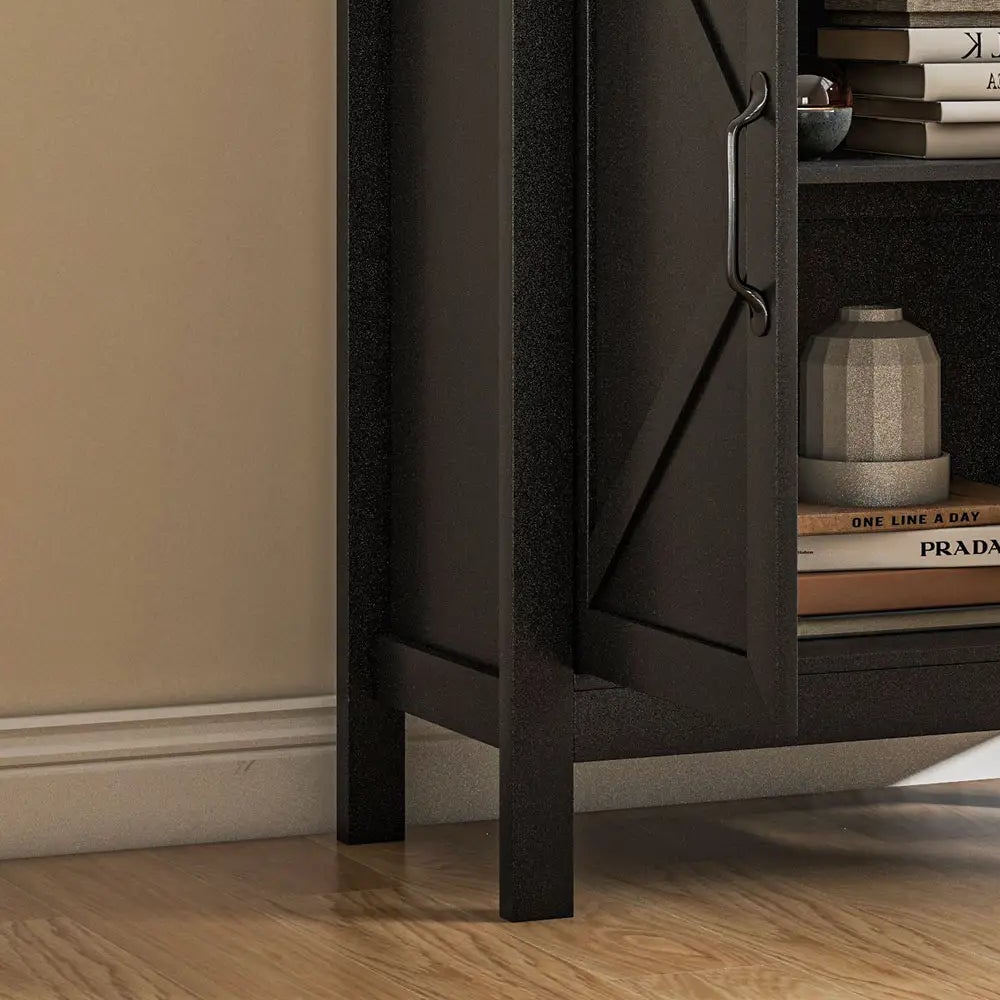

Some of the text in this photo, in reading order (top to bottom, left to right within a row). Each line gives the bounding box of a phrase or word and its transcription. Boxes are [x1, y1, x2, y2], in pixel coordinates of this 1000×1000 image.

[852, 511, 981, 528] ONE LINE A DAY
